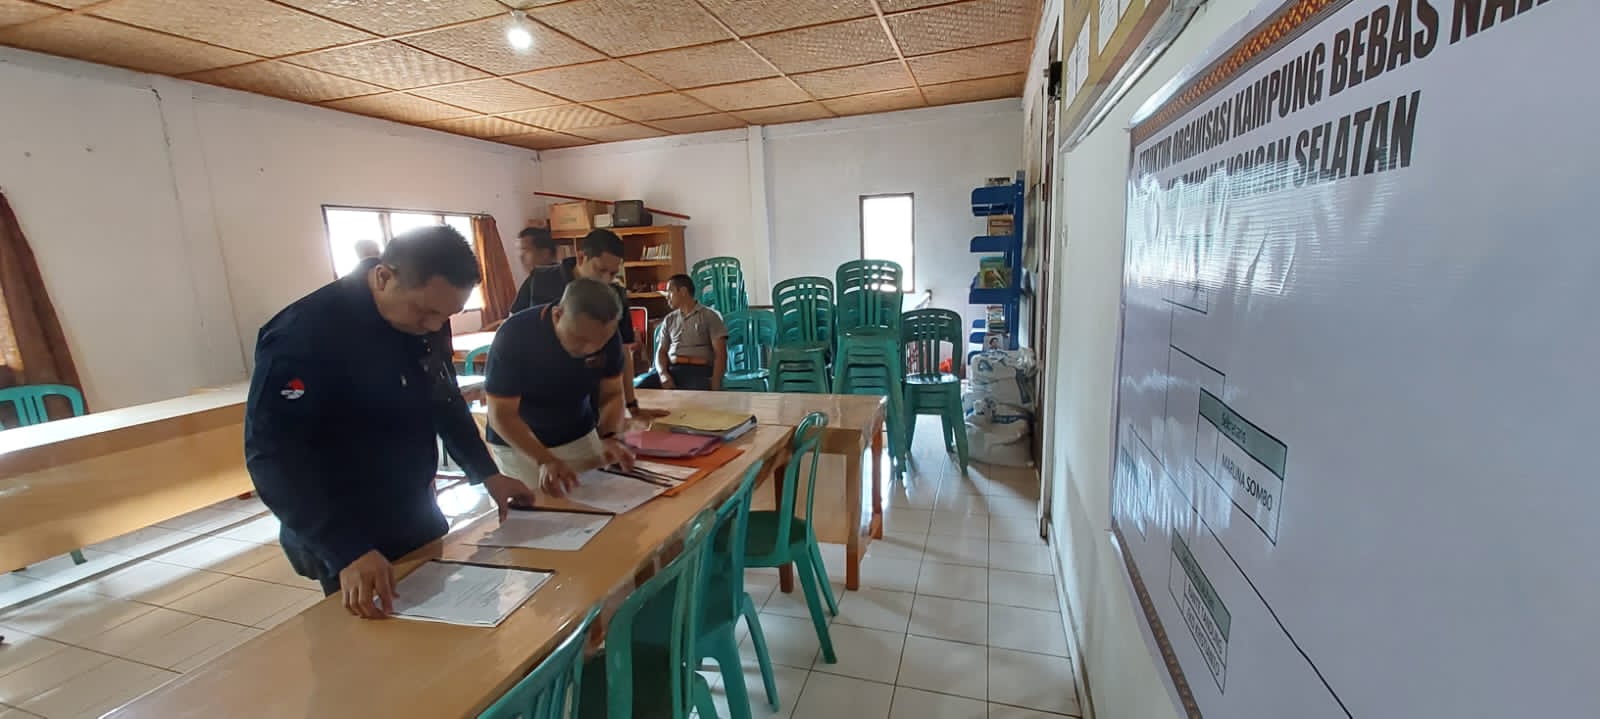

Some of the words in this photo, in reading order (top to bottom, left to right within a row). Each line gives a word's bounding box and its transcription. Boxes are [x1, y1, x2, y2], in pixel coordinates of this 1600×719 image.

[1172, 98, 1232, 165] ORGANISASI
[1233, 42, 1326, 138] KAMPUNG
[1329, 0, 1439, 96] BEBAS
[1295, 90, 1421, 188] SELATAN
